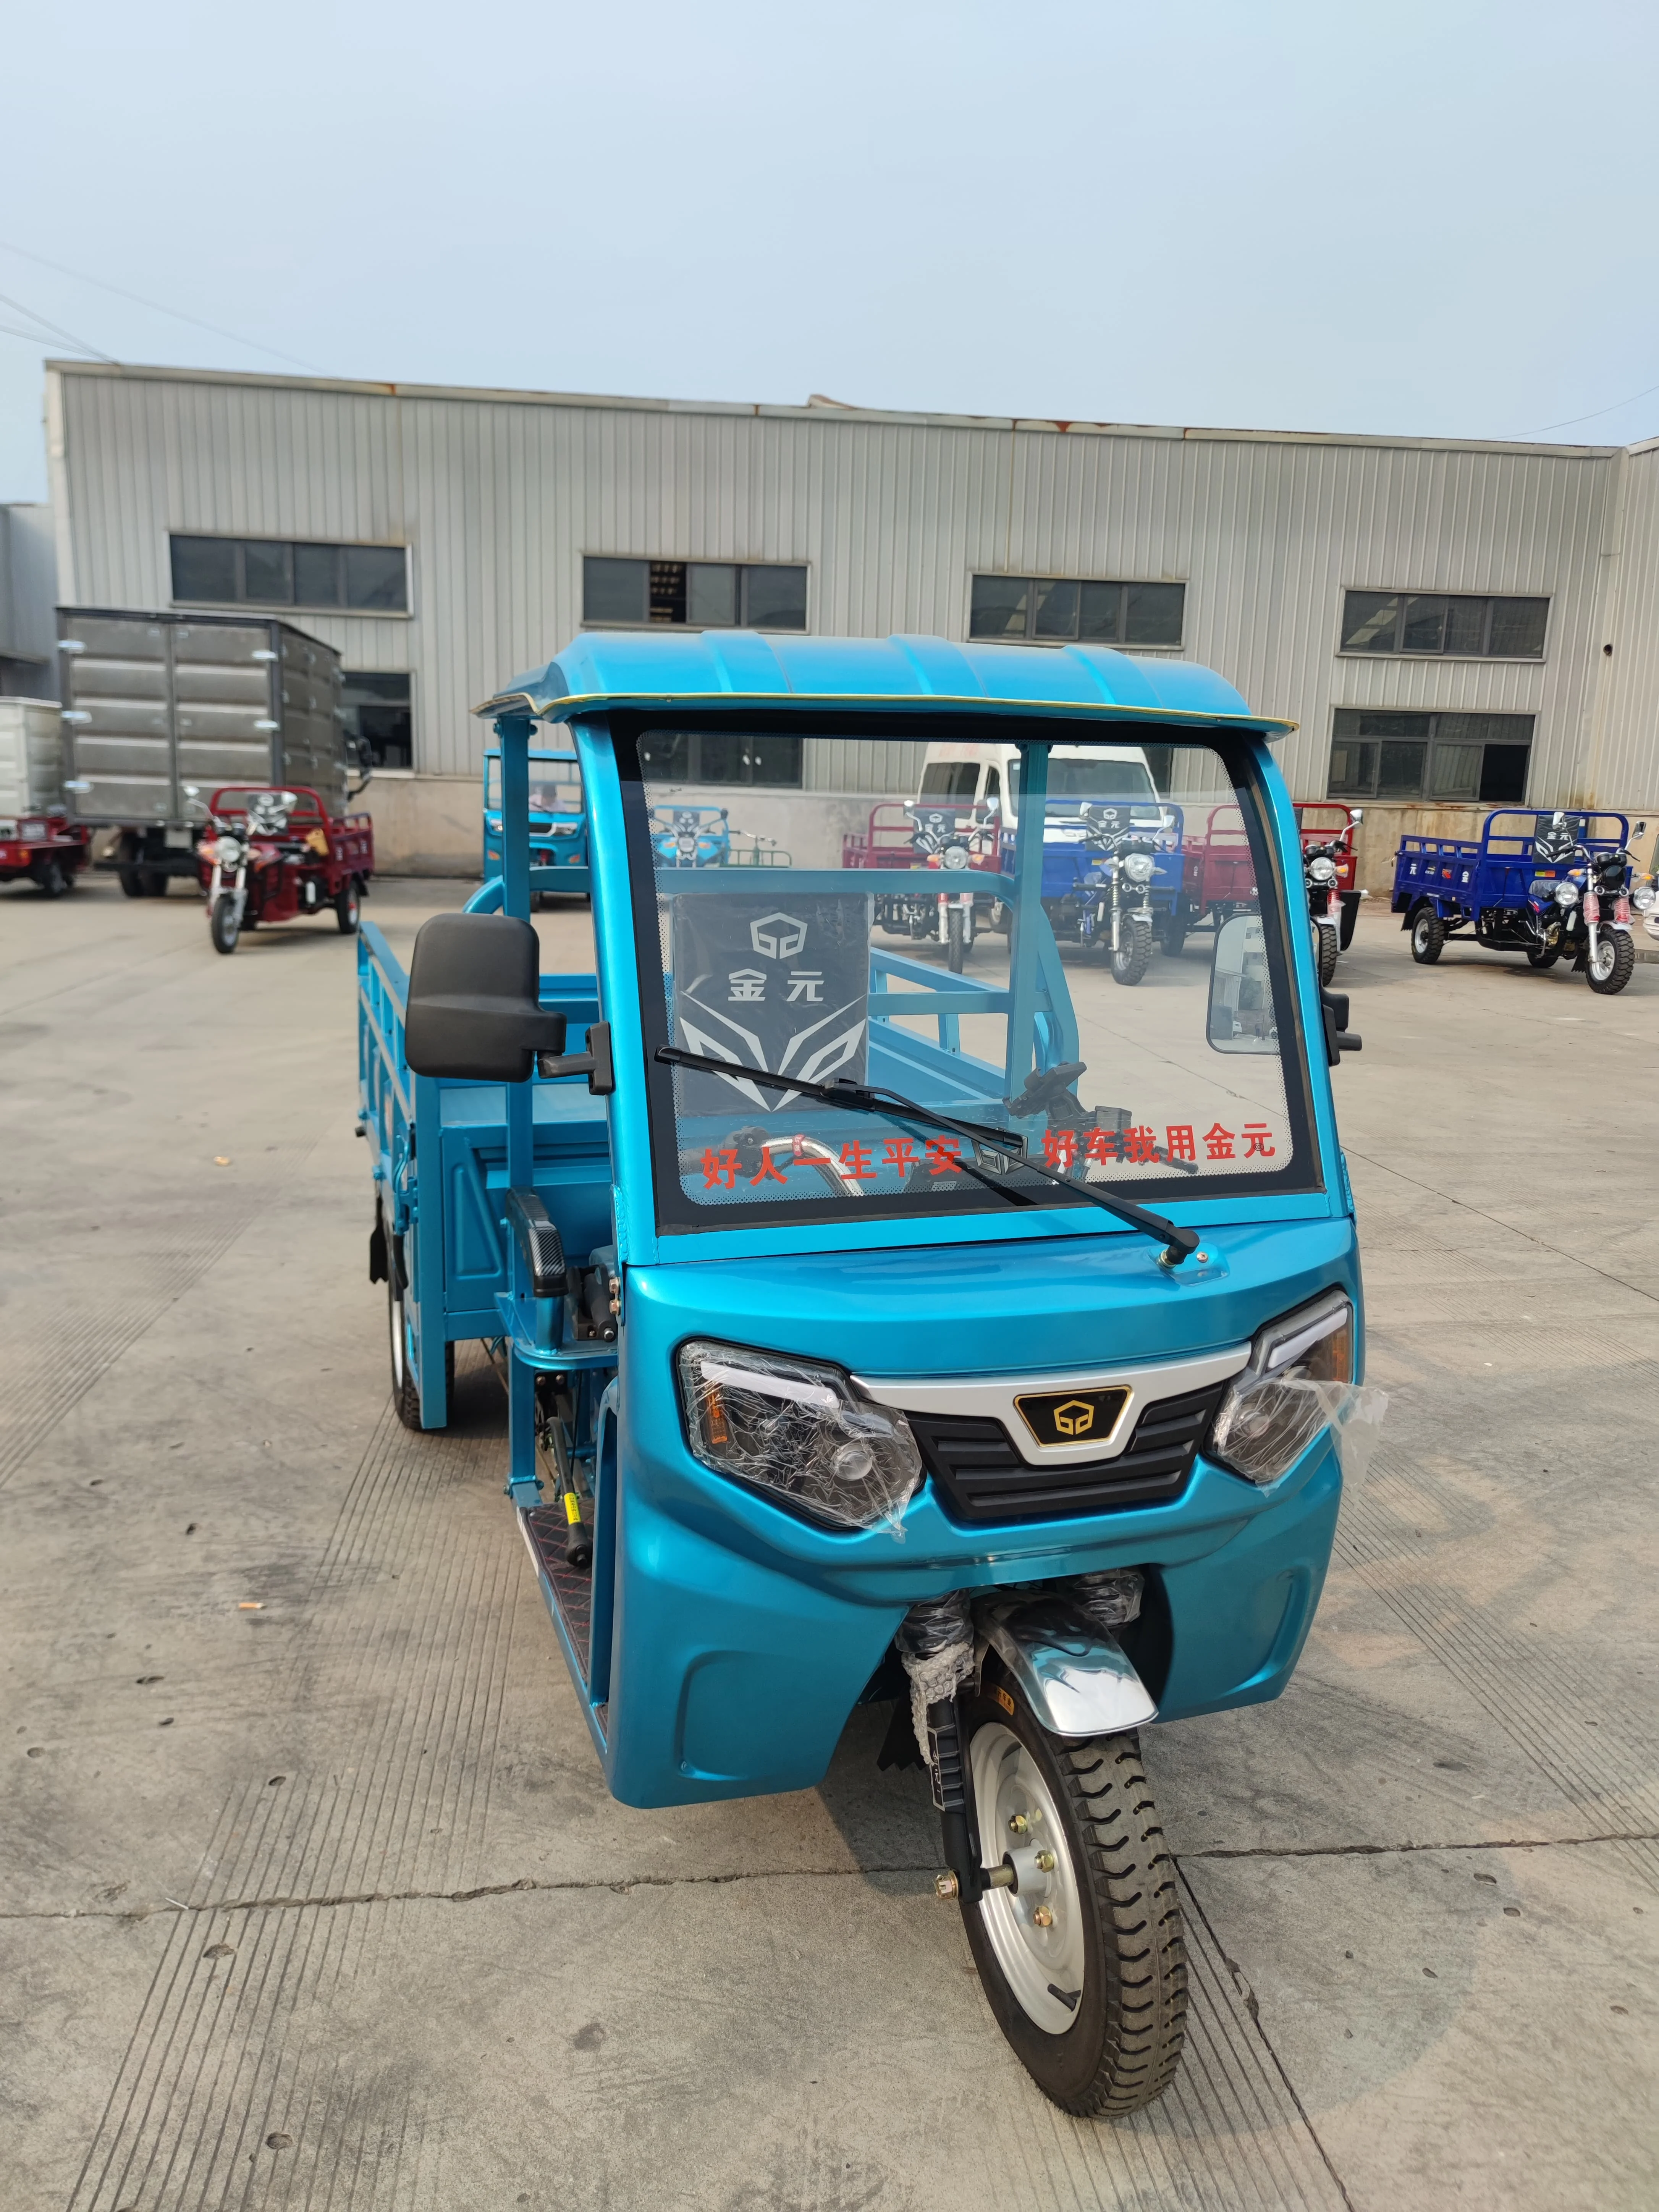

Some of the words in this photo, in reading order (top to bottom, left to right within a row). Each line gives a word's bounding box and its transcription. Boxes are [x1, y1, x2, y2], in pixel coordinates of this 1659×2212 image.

[1547, 831, 1569, 840] 金元
[728, 968, 825, 1002] 金元
[700, 1135, 962, 1190] 好人一生平安
[1041, 1122, 1276, 1168] 好车我用金元
